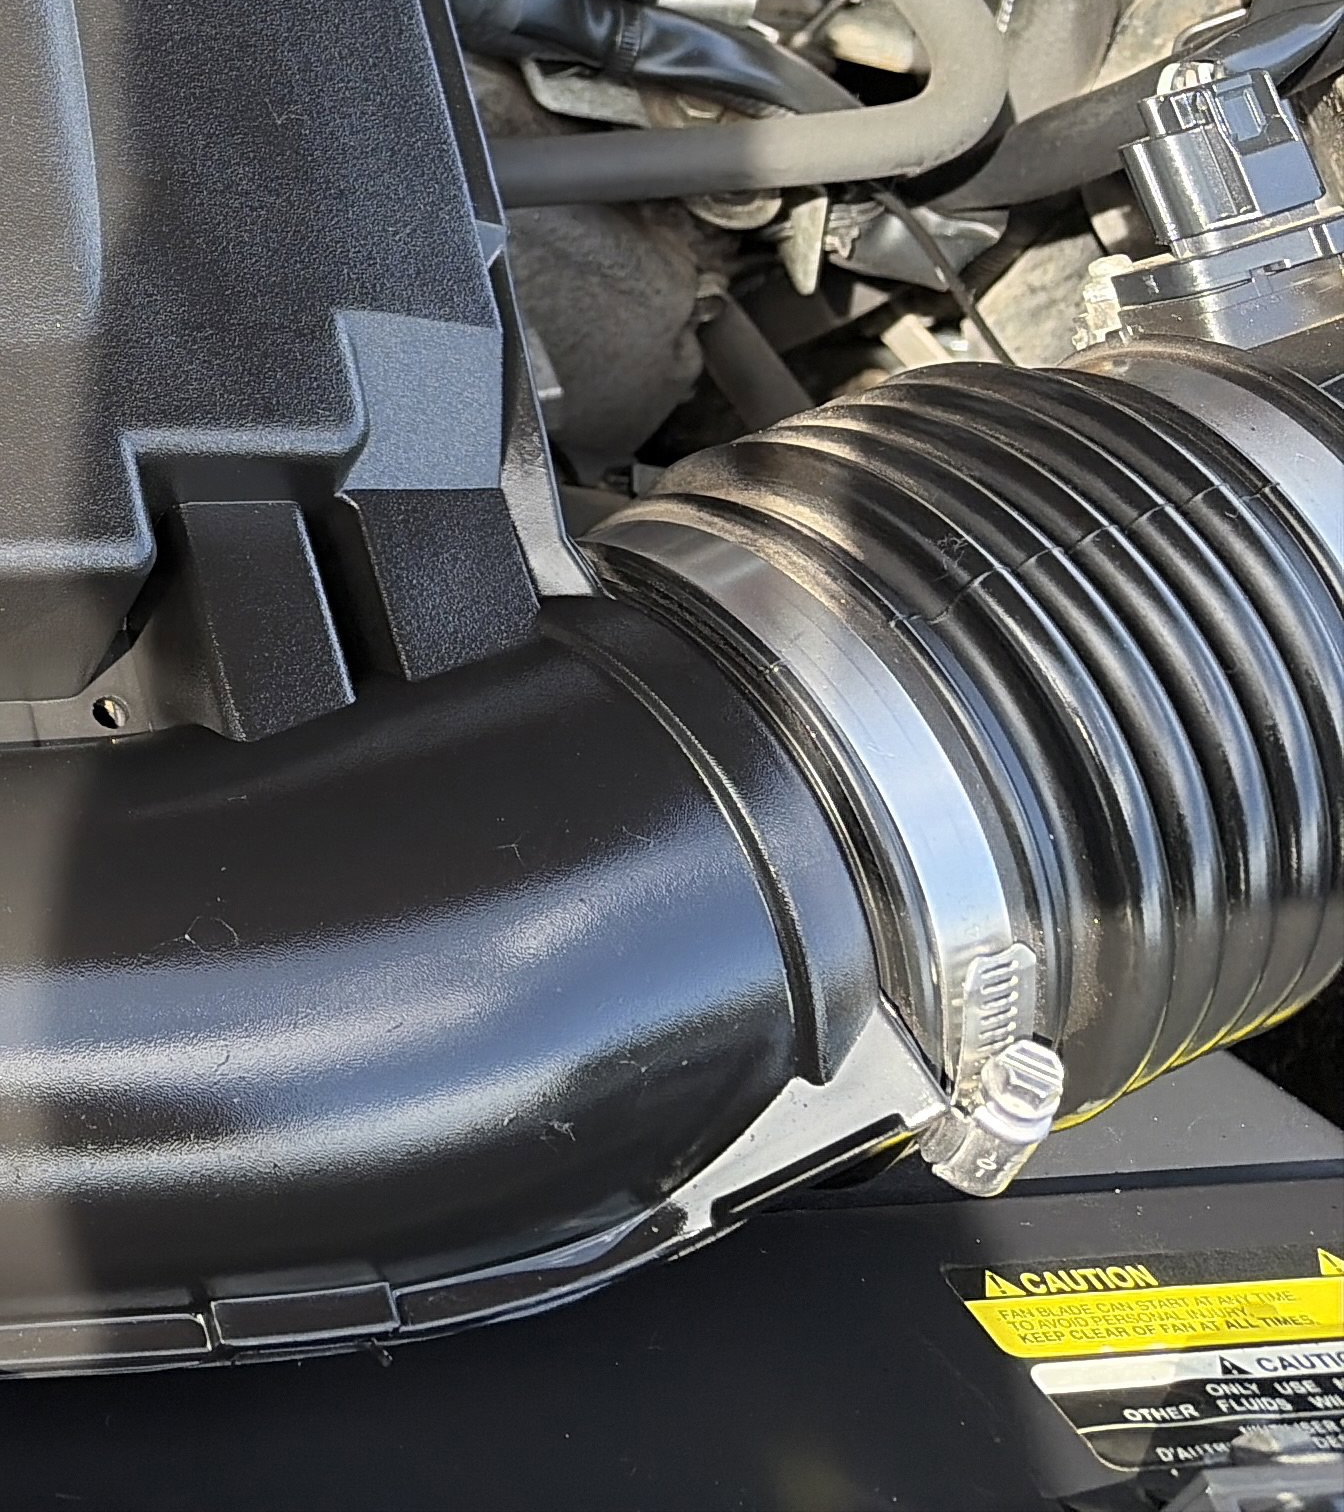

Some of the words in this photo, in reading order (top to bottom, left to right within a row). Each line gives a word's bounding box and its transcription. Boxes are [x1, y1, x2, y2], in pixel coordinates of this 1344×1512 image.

[1019, 1264, 1159, 1295] CAUTION
[998, 1308, 1035, 1321] FAN
[1035, 1304, 1094, 1318] BLADE
[1096, 1301, 1134, 1314] CAN
[1135, 1296, 1191, 1311] START
[1194, 1295, 1214, 1308] AT
[1218, 1293, 1250, 1306] ANY
[1007, 1319, 1034, 1332] TO
[1037, 1316, 1089, 1330] AVOID
[1089, 1310, 1186, 1327] PERSONAL
[1017, 1330, 1066, 1345] KEEP
[1069, 1326, 1130, 1341] CLEAR
[1132, 1324, 1156, 1337] OF
[1160, 1321, 1196, 1334] FAN
[1199, 1320, 1221, 1332] AT
[1224, 1317, 1260, 1330] ALL
[1205, 1382, 1261, 1398] ONLY
[1273, 1379, 1323, 1395] USE
[1123, 1402, 1201, 1422] OTHER
[1216, 1397, 1294, 1414] FLUIDS
